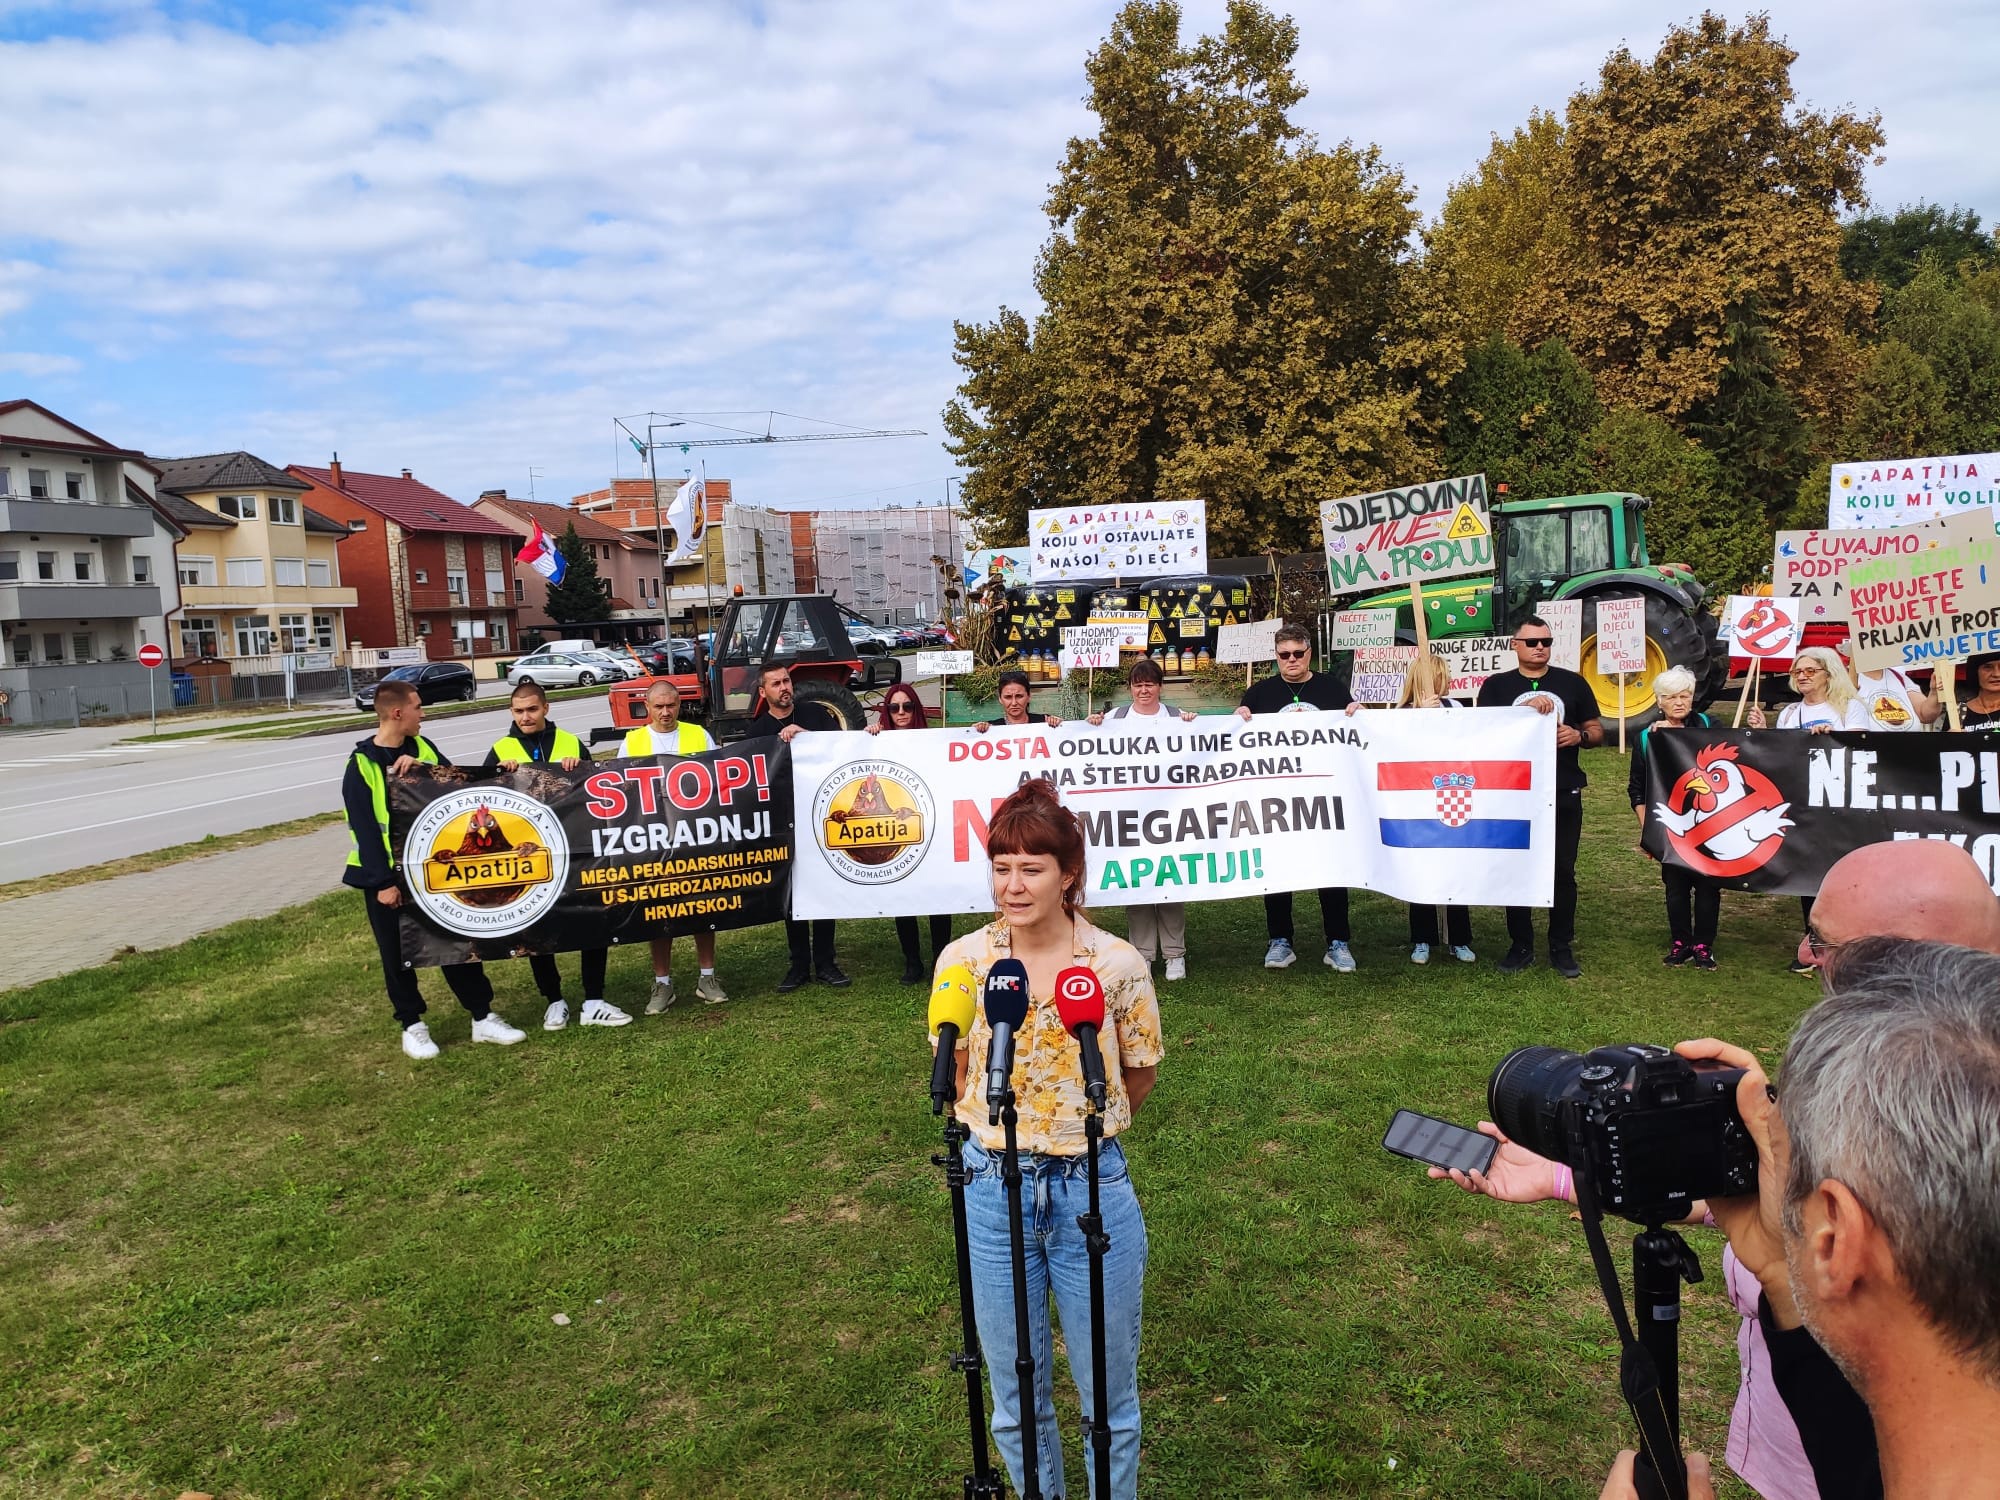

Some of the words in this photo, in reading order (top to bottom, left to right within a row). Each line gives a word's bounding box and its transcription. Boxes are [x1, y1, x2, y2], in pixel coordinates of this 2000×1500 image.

[1871, 464, 1978, 482] APATIJA
[1331, 475, 1488, 532] DJEDOVINA
[1846, 494, 1895, 509] KOJU
[1907, 493, 1932, 507] MI
[1069, 509, 1155, 525] APATIJA
[1041, 535, 1077, 548] KOJU
[1083, 533, 1098, 545] VI
[1105, 529, 1195, 544] OSTAVLJATE
[1364, 509, 1453, 554] NIJE
[1803, 531, 1920, 557] ČUVAJMO
[1050, 553, 1099, 568] NAŠOJ
[1126, 552, 1178, 566] DJECI
[1329, 552, 1379, 589] NA
[1388, 535, 1493, 577] PRODAJU
[1790, 582, 1821, 597] ZA
[1851, 568, 1964, 608] KUPUJETE
[1600, 600, 1644, 612] TRUJETE
[1852, 593, 1960, 628] TRUJETE
[1373, 613, 1392, 622] NAM
[1603, 621, 1635, 633] DJECU
[1067, 629, 1076, 637] MI
[1081, 627, 1119, 638] HODAMO
[1349, 624, 1377, 633] UZETI
[1858, 618, 1940, 650] PRLJAVI
[1073, 646, 1102, 654] GLAVE
[1336, 634, 1393, 647] BUDUĆNOST
[1430, 640, 1467, 655] DRUGE
[1601, 640, 1622, 650] BOLI
[1075, 655, 1083, 667] A
[1461, 655, 1501, 672] ŽELE
[1611, 650, 1629, 660] VAS
[1619, 659, 1646, 670] BRIGA
[948, 736, 1051, 762] DOSTA
[1058, 735, 1160, 757] ODLUKA
[1166, 735, 1183, 753] U
[1190, 733, 1232, 752] IME
[1238, 727, 1369, 751] GRAĐANA,
[1084, 763, 1161, 786] ŠTETU
[1167, 756, 1303, 784] GRAĐANA!
[584, 753, 771, 820] STOP!
[823, 771, 847, 797] STOP
[850, 765, 885, 775] FARMI
[423, 804, 452, 834] STOP
[457, 796, 498, 808] FARMI
[1080, 795, 1346, 848] MEGAFARMI
[591, 811, 771, 857] IZGRADNJI
[839, 820, 908, 843] Apatija
[445, 858, 533, 884] Apatija
[580, 866, 630, 886] MEGA
[632, 851, 744, 878] PERADARSKIH
[745, 846, 789, 866] FARMI
[835, 857, 853, 873] SELO
[894, 854, 916, 872] KOKA
[1100, 847, 1264, 890] APATIJI!
[602, 888, 615, 905] U
[616, 870, 772, 904] SJEVEROZAPADNOJ
[440, 902, 462, 919] SELO
[519, 893, 544, 915] KOKA
[644, 894, 742, 921] HRVATSKOJ!
[989, 976, 1020, 991] HRT
[1668, 1191, 1686, 1199] Nikon
